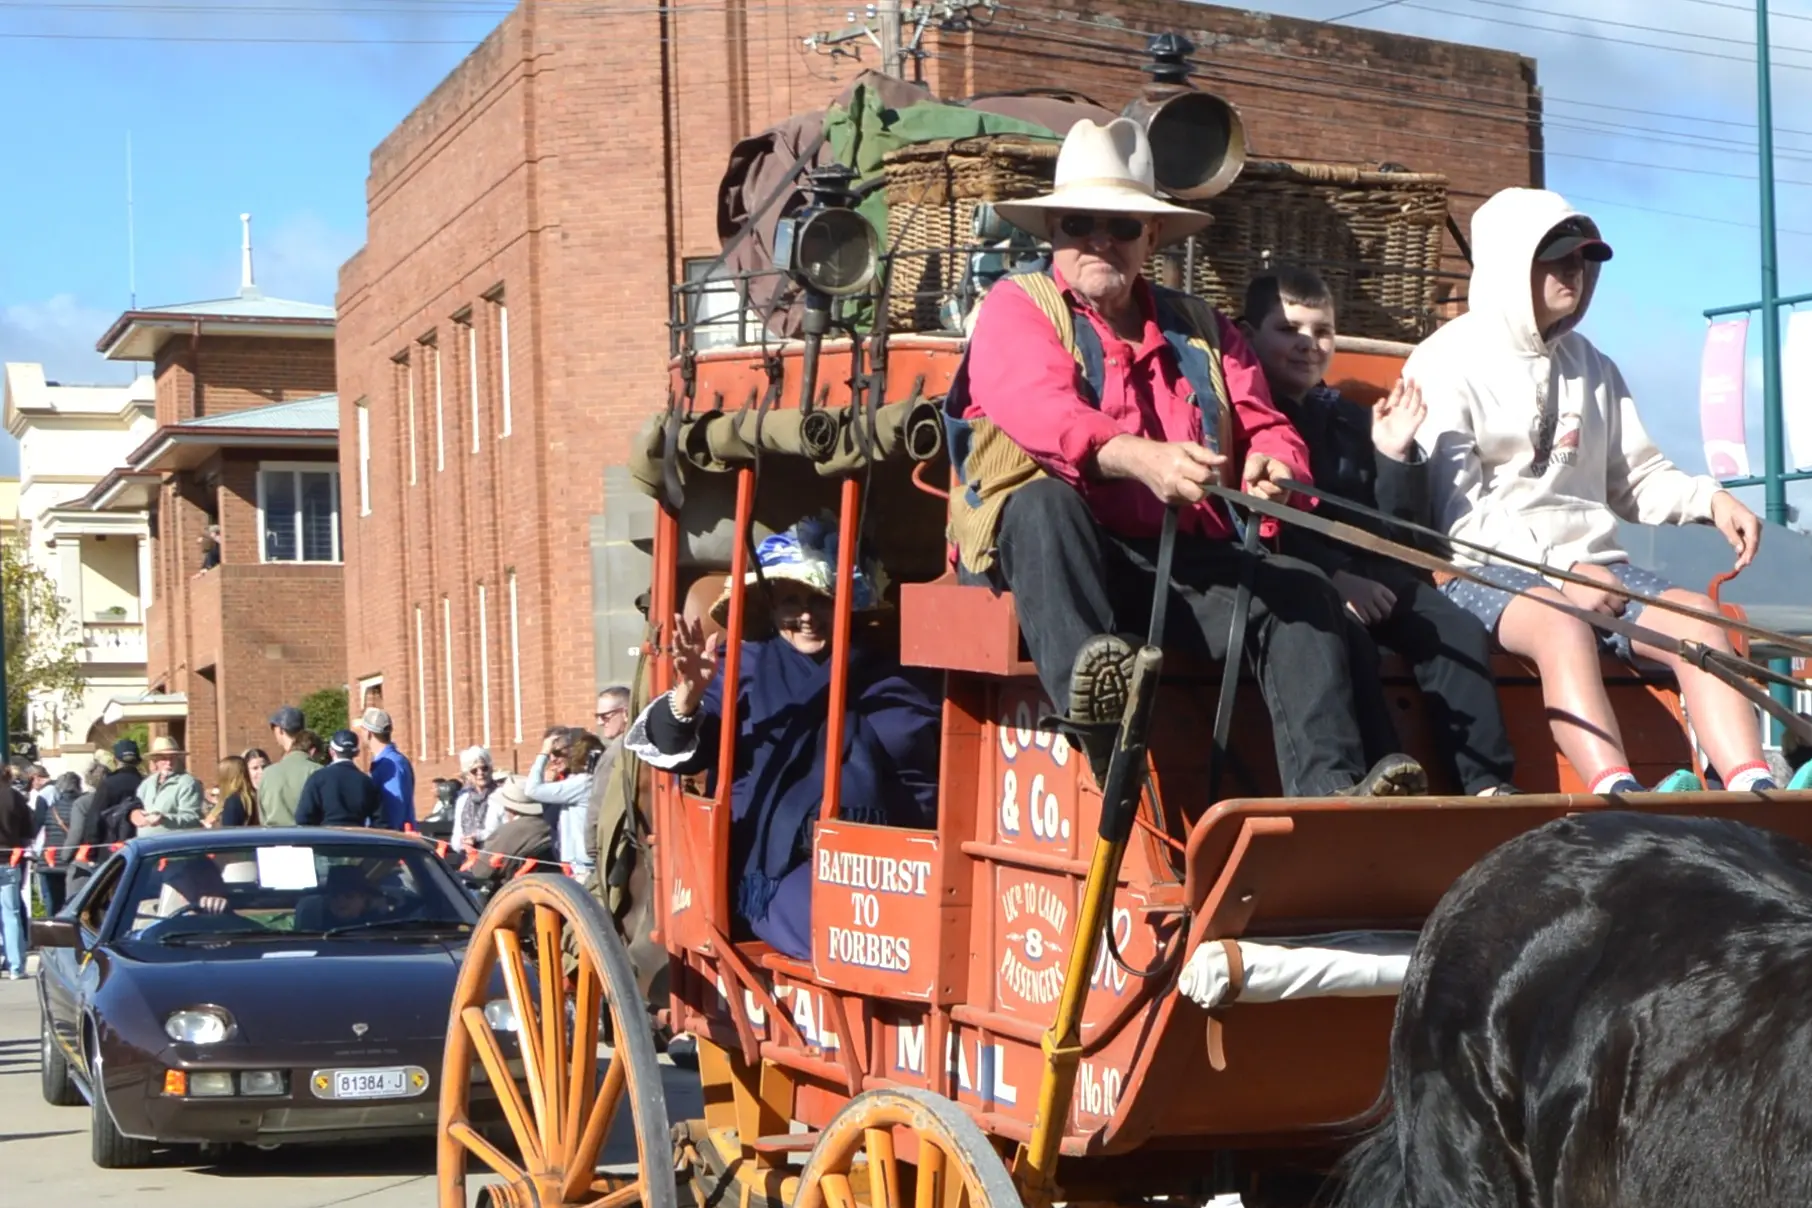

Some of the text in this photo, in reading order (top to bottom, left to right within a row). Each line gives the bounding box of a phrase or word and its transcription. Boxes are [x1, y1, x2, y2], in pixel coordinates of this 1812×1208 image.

[1002, 768, 1071, 839] & Co.
[818, 848, 931, 896] BATHURST
[851, 892, 880, 928] TO
[1023, 881, 1037, 915] TO
[828, 926, 911, 972] FORBES
[1025, 927, 1043, 959] 8
[1001, 946, 1065, 1005] PASSENGERS
[897, 1017, 1017, 1104] MAIL
[1080, 1061, 1101, 1114] No
